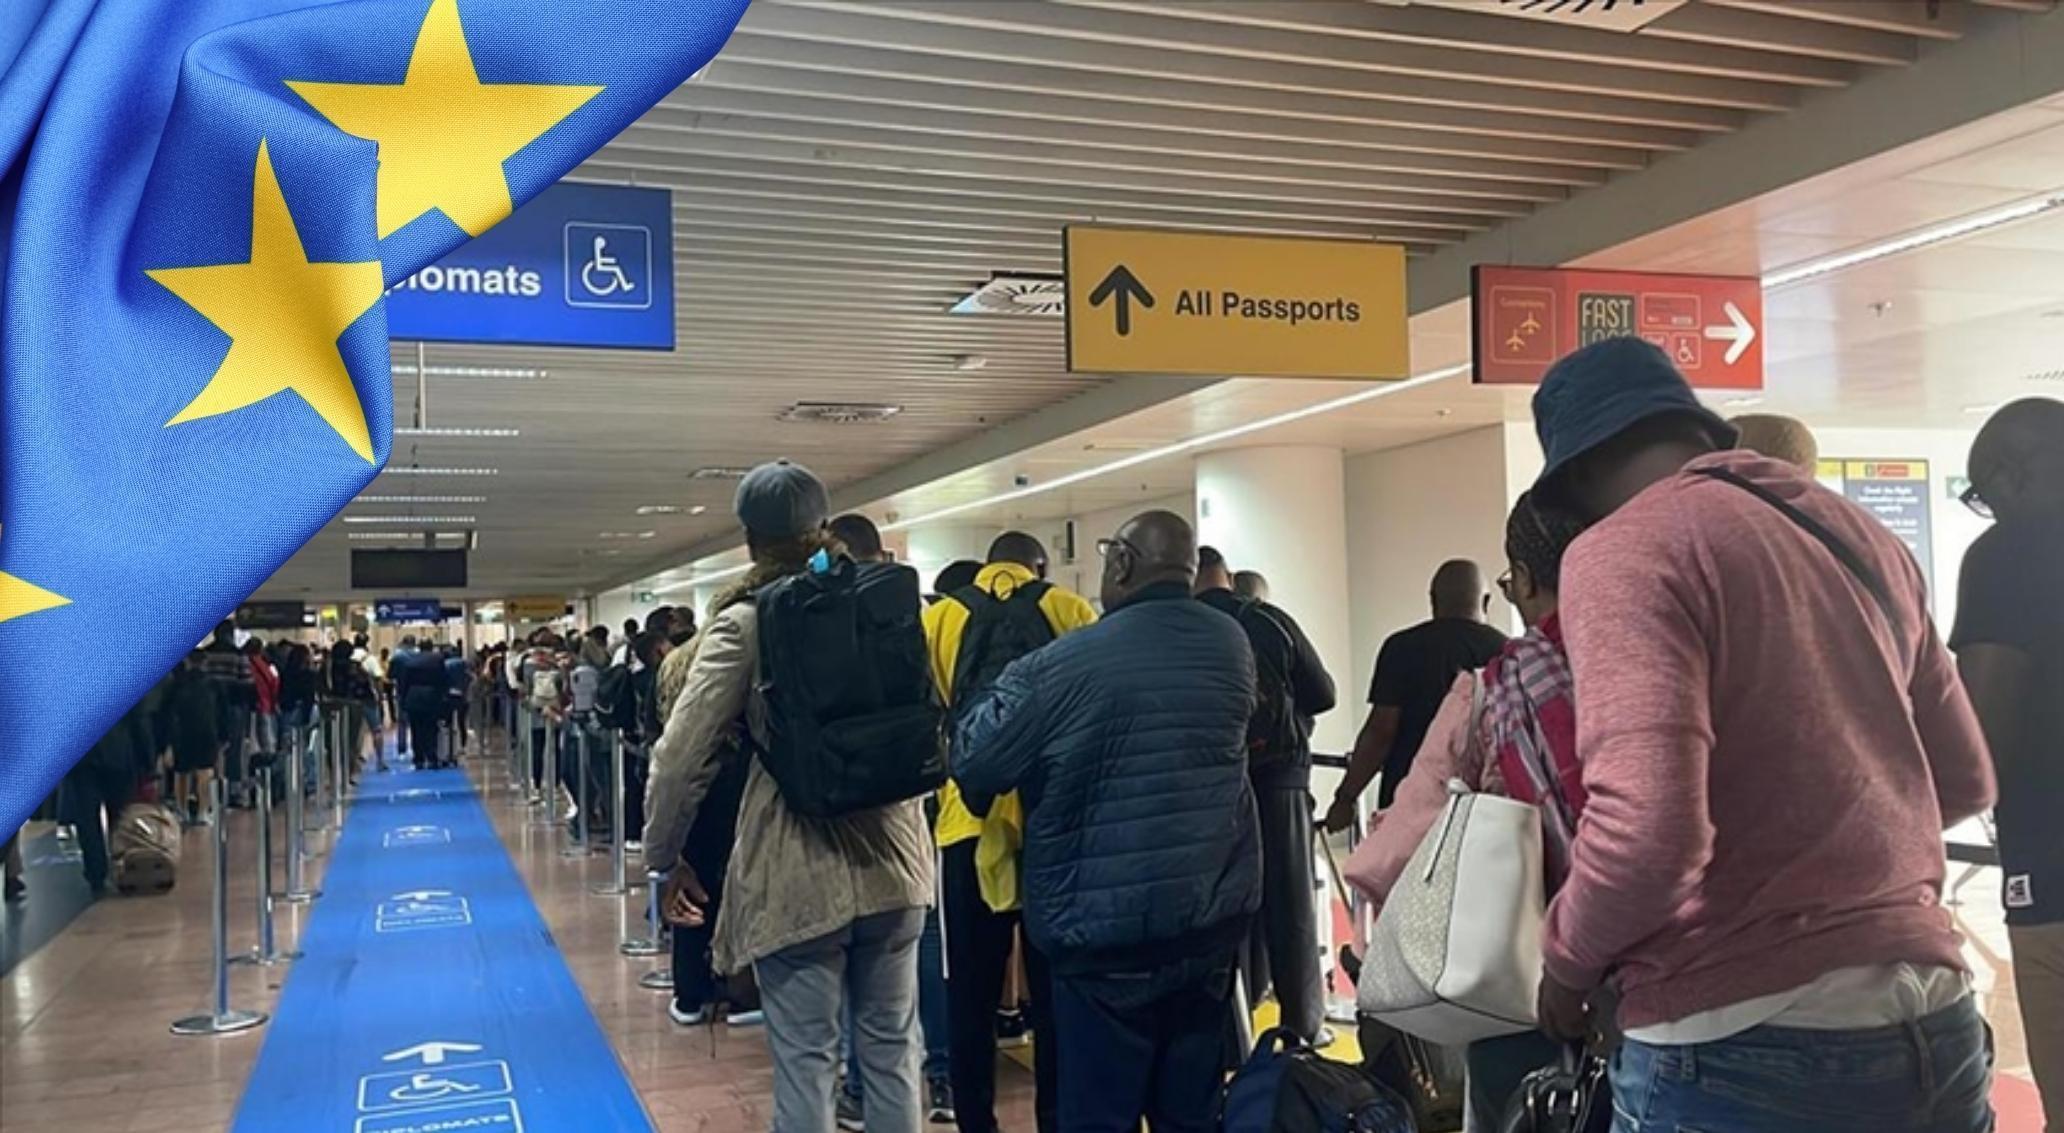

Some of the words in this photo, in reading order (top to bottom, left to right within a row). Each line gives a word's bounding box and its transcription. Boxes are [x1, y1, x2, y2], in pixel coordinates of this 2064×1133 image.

[1175, 290, 1212, 316] All
[1223, 292, 1360, 325] Passports
[1582, 298, 1632, 328] FAST
